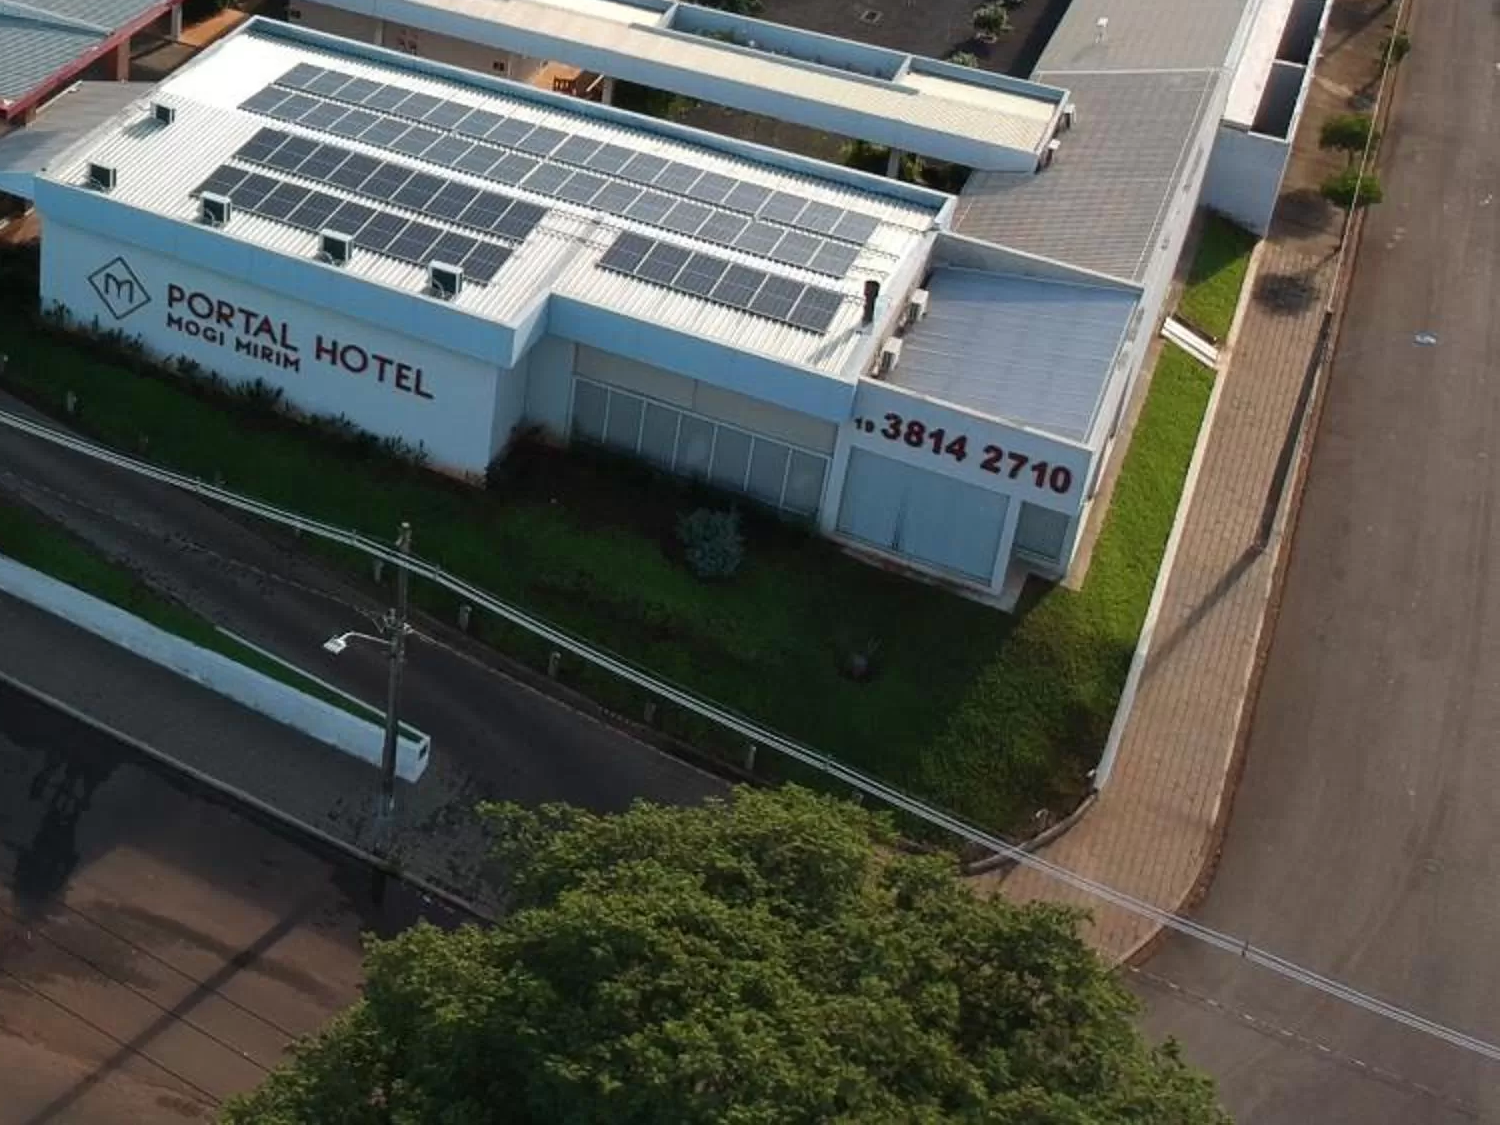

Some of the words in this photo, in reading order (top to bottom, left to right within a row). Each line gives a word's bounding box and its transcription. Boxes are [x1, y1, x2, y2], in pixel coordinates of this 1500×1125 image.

[166, 311, 225, 346] MOGI
[235, 336, 300, 373] MIRIM
[167, 283, 298, 352] PORTAL
[314, 335, 434, 399] HOTEL
[880, 413, 968, 462] 3814
[979, 445, 1072, 494] 2710
